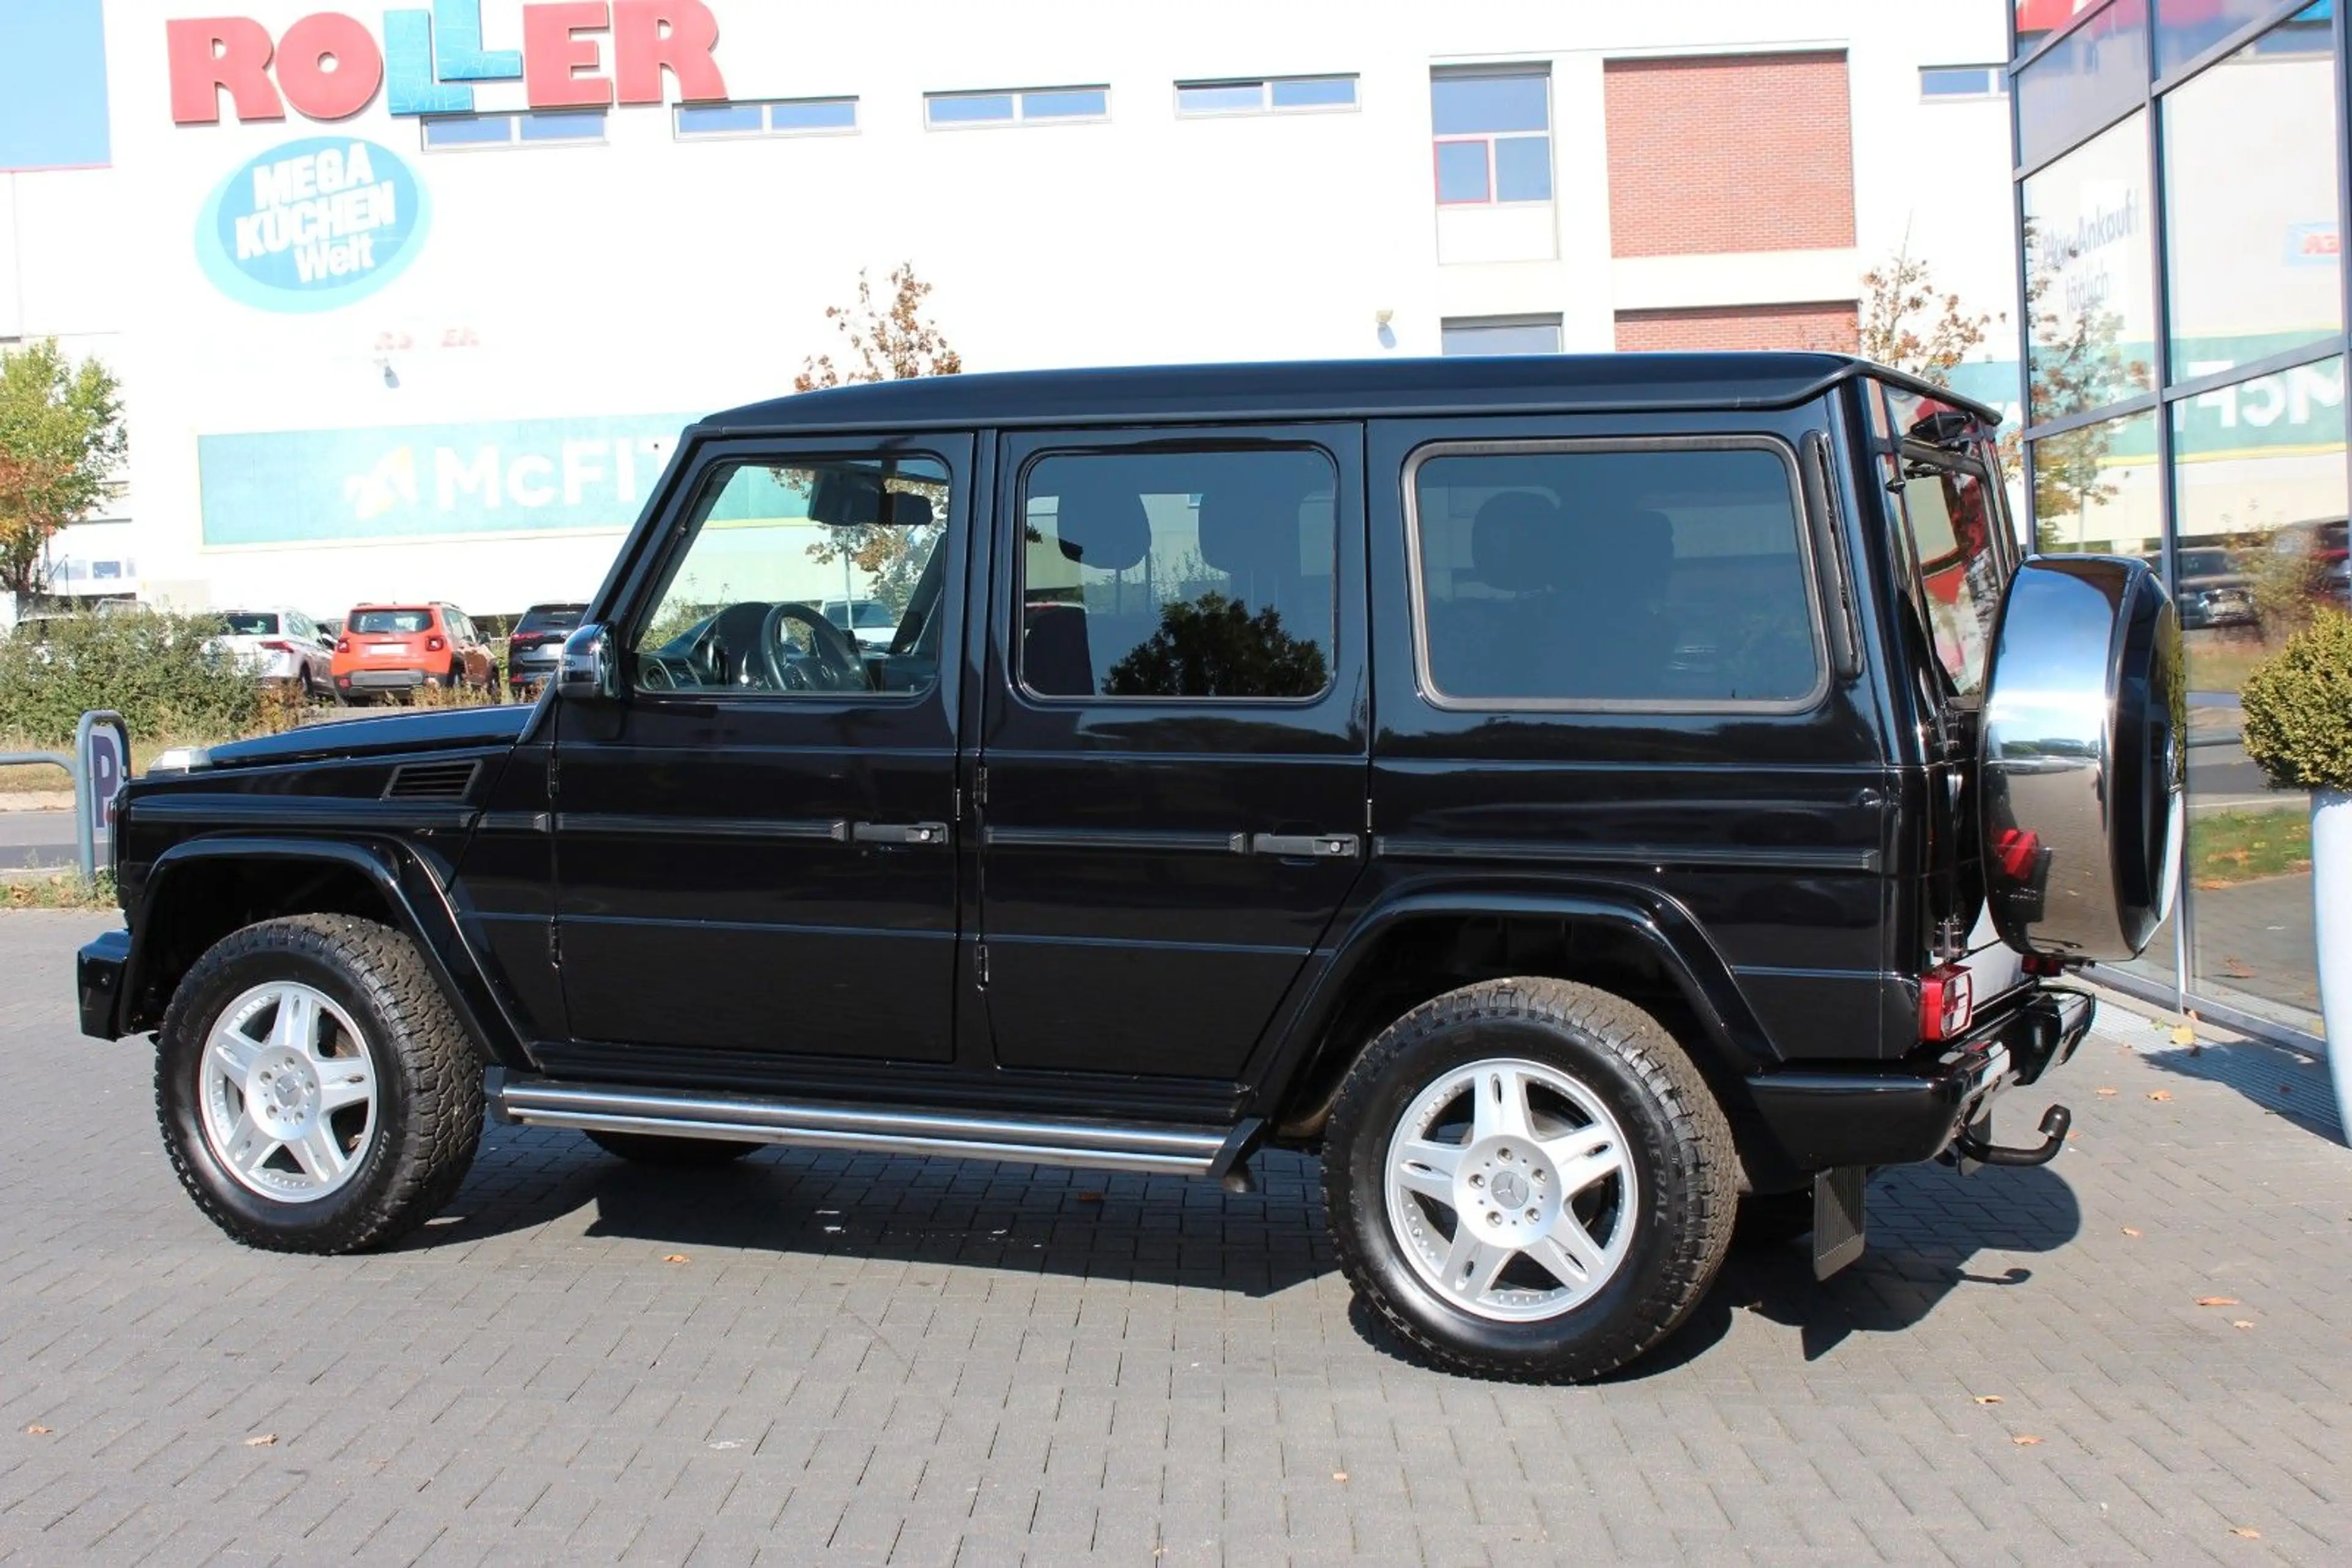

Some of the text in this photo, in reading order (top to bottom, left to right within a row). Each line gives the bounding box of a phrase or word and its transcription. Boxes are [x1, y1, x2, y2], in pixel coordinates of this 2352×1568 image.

[167, 0, 728, 125] ROLLER
[252, 141, 375, 209] MEGA
[293, 234, 375, 283] Welt
[91, 734, 118, 828] P
